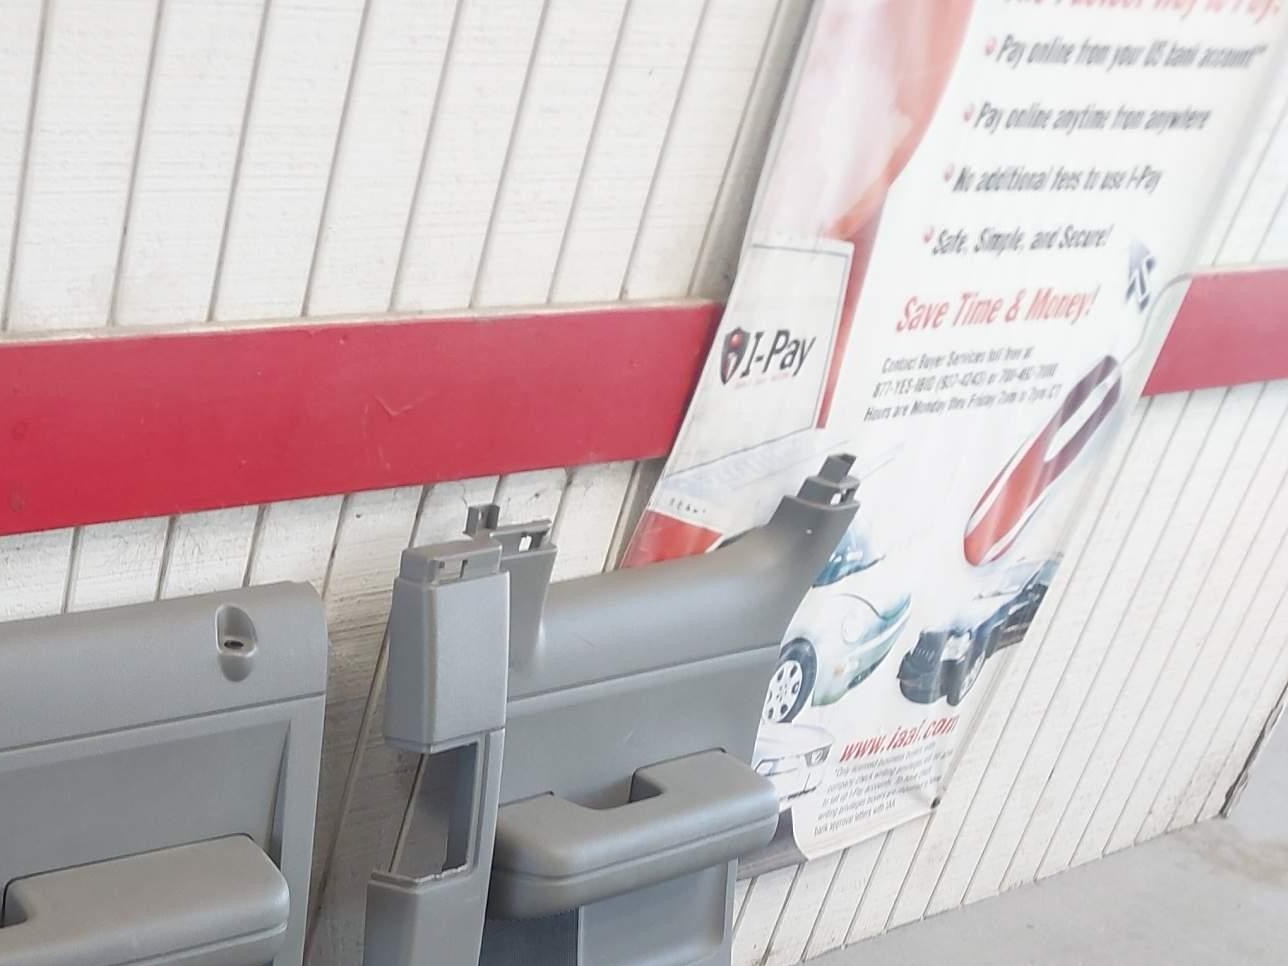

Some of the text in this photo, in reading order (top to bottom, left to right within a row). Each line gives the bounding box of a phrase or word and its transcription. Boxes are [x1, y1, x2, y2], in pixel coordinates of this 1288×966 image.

[996, 33, 1026, 69] Pay
[1027, 36, 1074, 66] online
[1074, 37, 1110, 66] from
[973, 100, 1212, 134] Pay online anytime from anywhere
[953, 166, 975, 192] No
[975, 164, 1053, 192] additional
[1050, 166, 1083, 192] fees
[1082, 168, 1100, 191] to
[1099, 171, 1127, 191] use
[1029, 224, 1063, 251] and
[1058, 222, 1114, 250] Secure!
[896, 284, 1102, 333] Save Time & Money!
[739, 329, 817, 378] I-Pay
